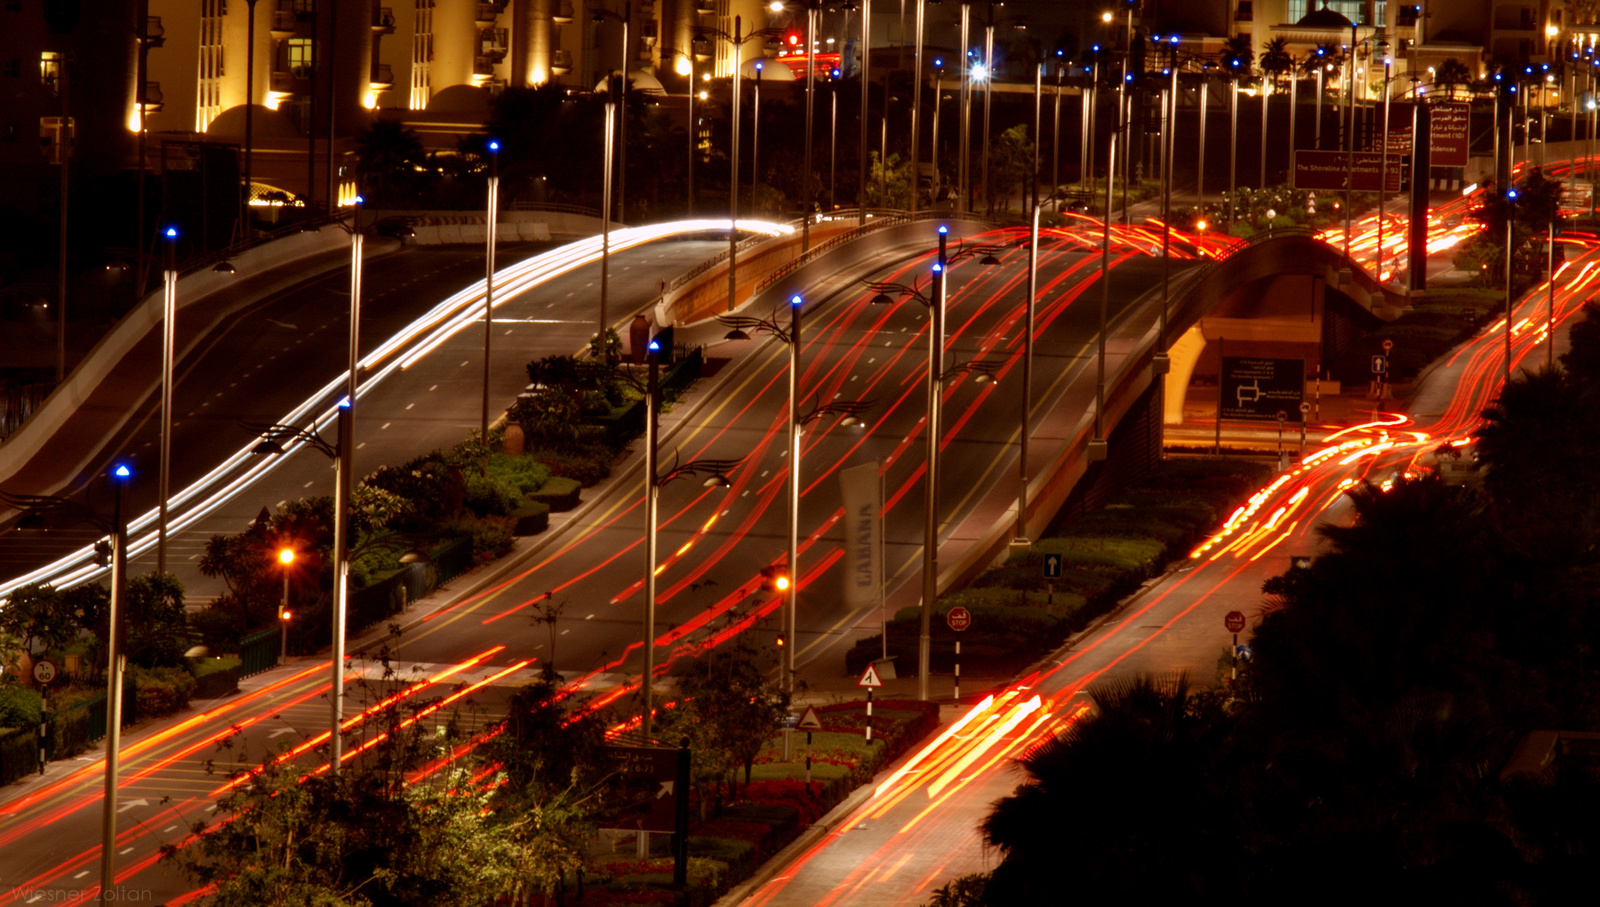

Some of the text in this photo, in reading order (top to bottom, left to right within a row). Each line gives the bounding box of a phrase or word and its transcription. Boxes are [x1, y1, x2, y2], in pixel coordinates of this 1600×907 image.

[951, 619, 968, 627] STOP
[1227, 622, 1243, 630] STOP
[39, 672, 51, 681] 60
